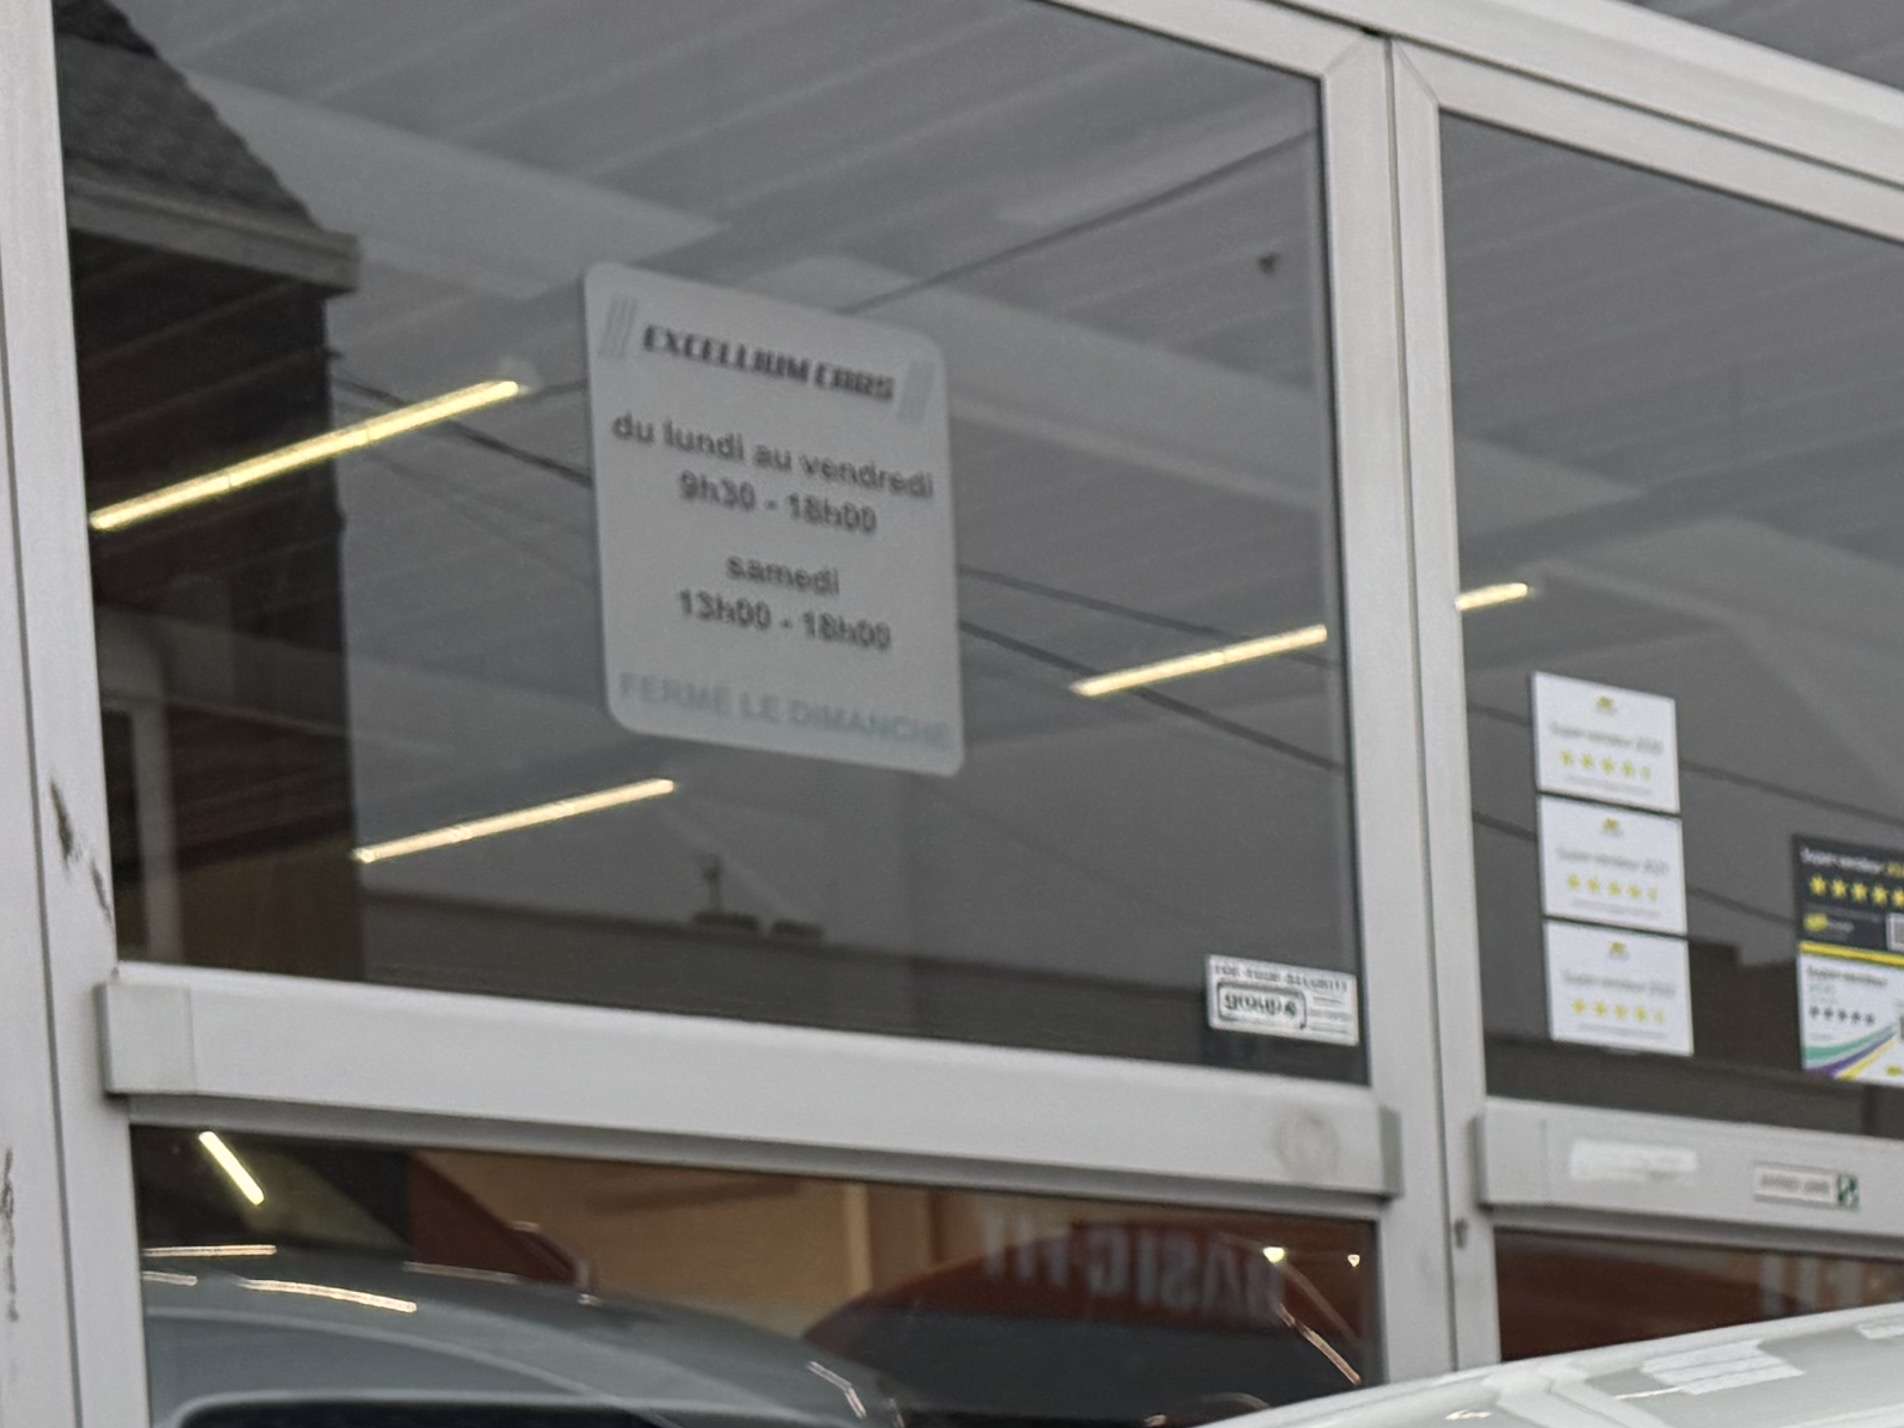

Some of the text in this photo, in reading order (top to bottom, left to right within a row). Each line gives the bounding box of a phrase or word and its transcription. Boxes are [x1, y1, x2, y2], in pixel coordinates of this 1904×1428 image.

[642, 323, 896, 402] EXCELLIUM CARS
[612, 412, 935, 500] du lundi au vendredi
[679, 471, 757, 512] 9h30
[788, 492, 878, 535] 18h00
[725, 555, 840, 597] samedi
[680, 589, 772, 632] 13h00
[803, 611, 892, 652] 18h00
